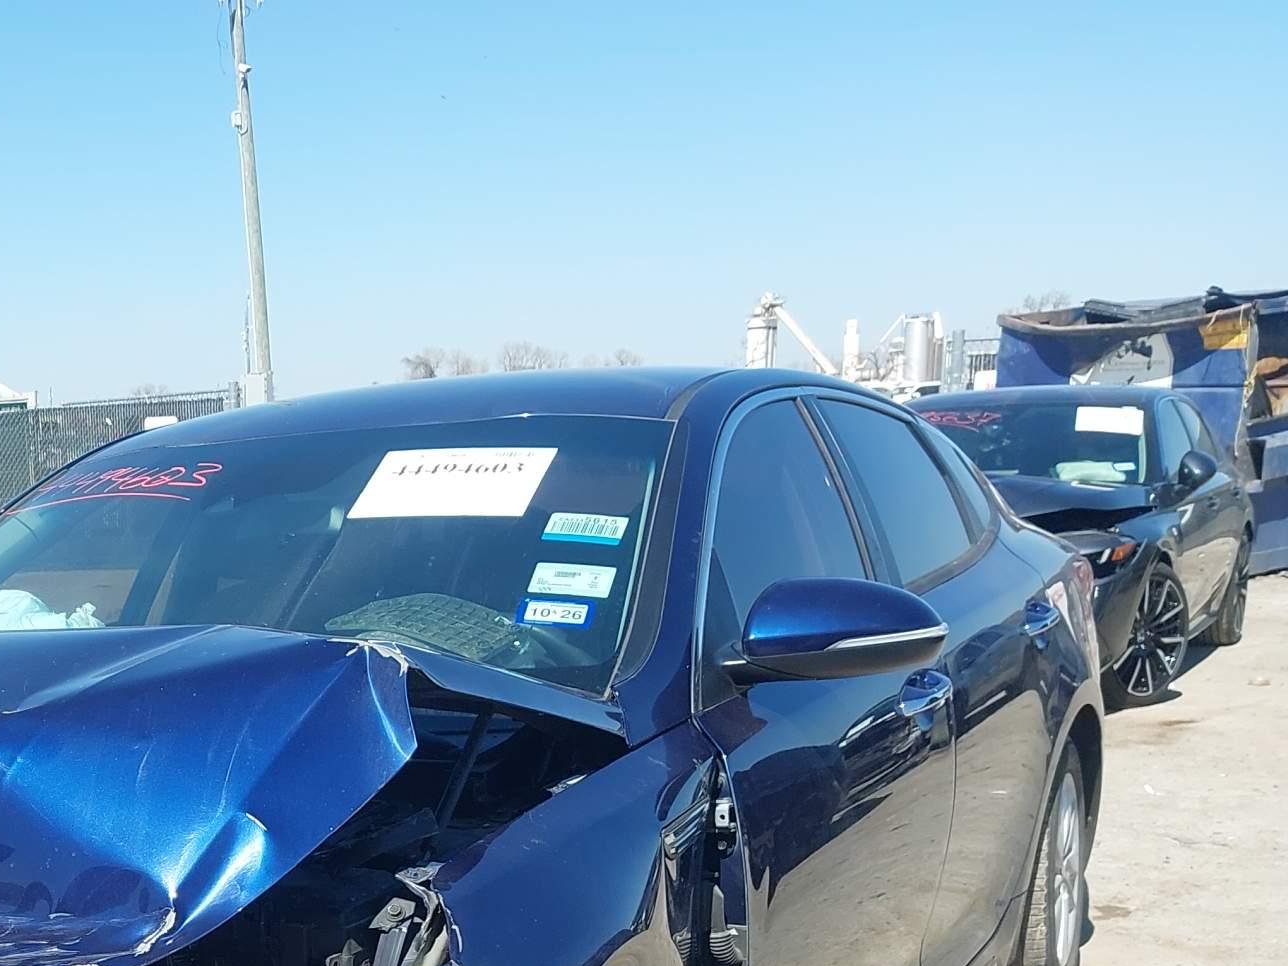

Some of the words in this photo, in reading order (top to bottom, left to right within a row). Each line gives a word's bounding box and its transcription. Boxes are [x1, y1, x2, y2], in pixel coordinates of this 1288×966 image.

[392, 462, 525, 476] 44494603
[531, 607, 551, 618] 10
[560, 609, 583, 620] 26
